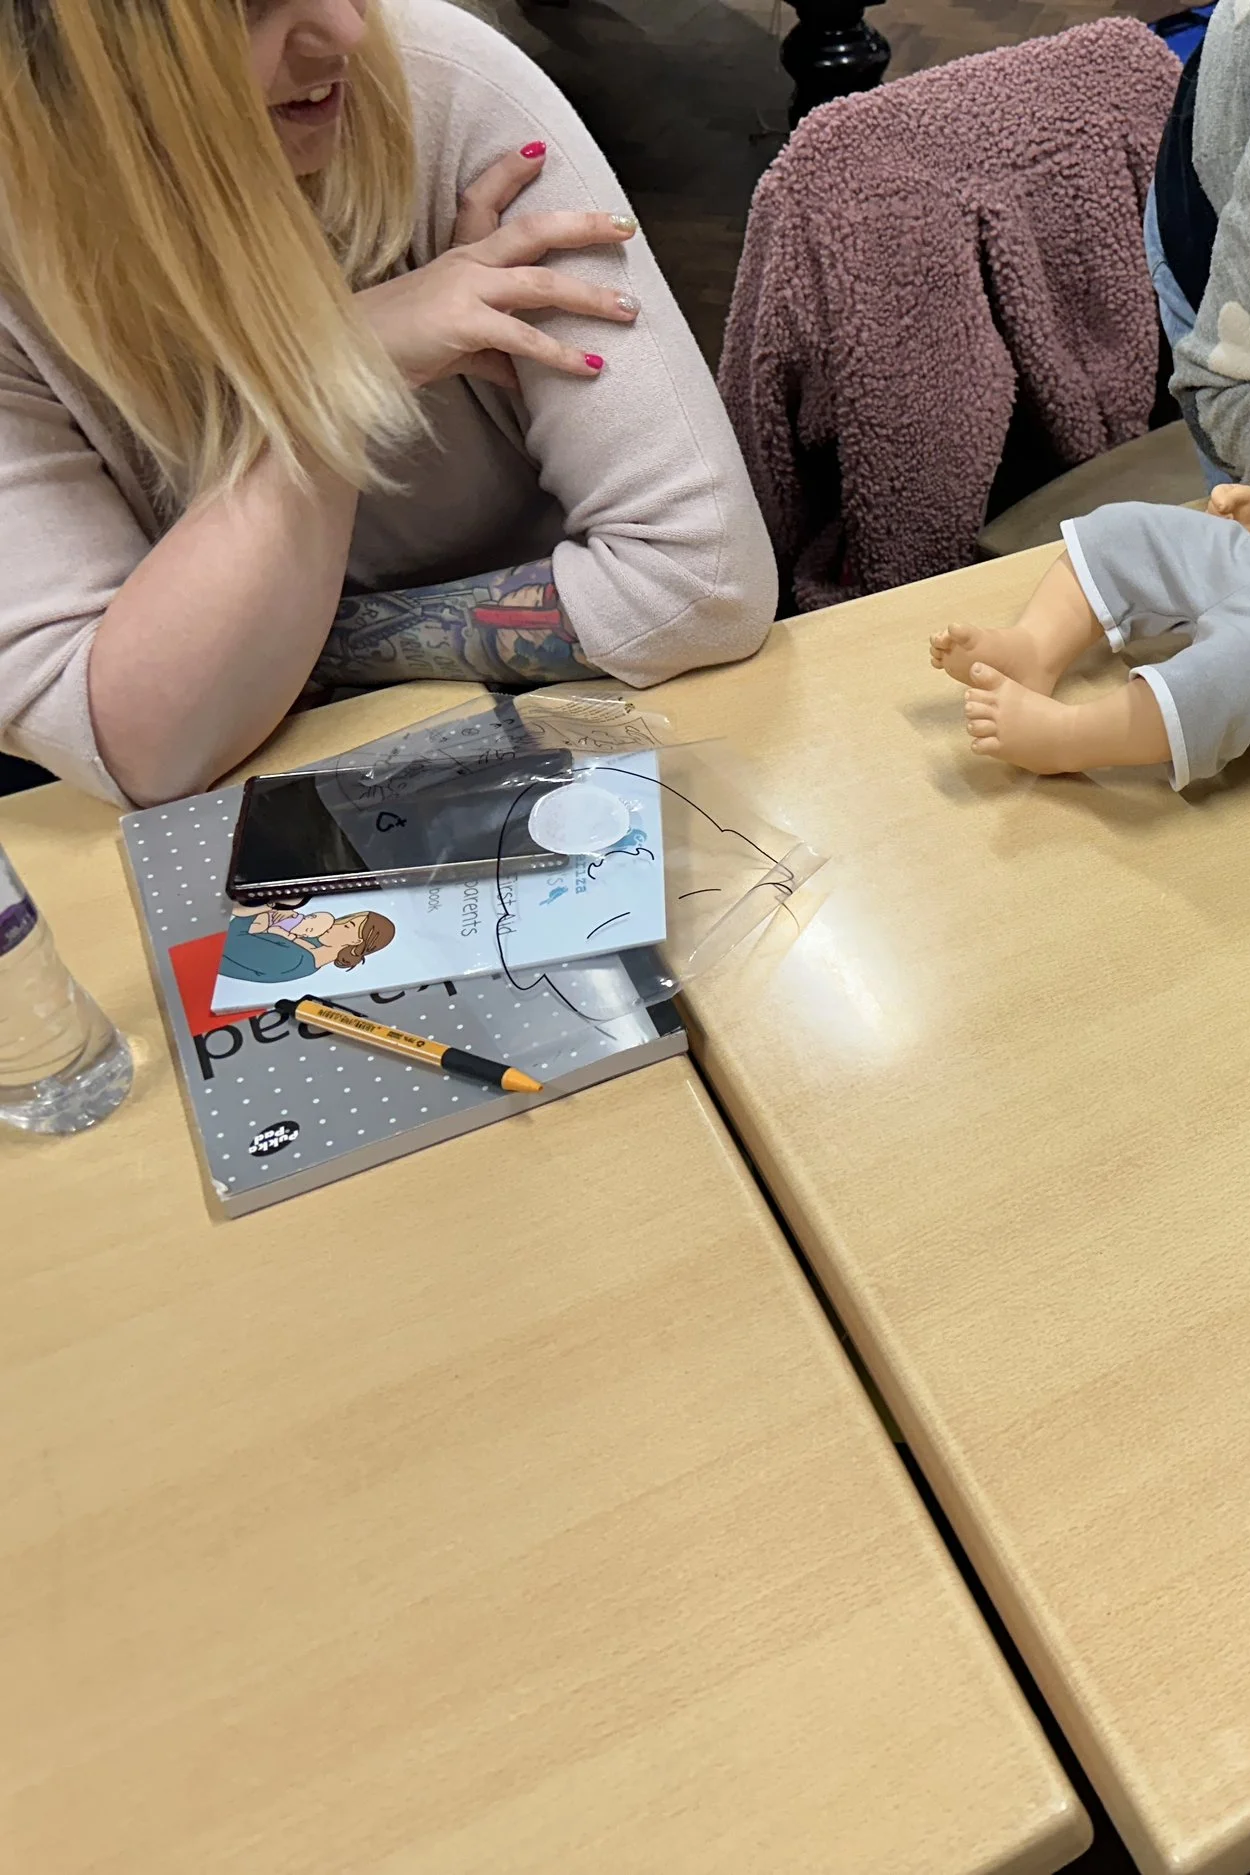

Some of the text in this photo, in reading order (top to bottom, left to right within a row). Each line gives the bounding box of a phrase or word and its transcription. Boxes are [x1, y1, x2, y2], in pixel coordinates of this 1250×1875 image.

[428, 886, 443, 914] book
[461, 879, 482, 938] parents
[248, 1130, 299, 1155] Pukka
[254, 1125, 285, 1145] Pad
